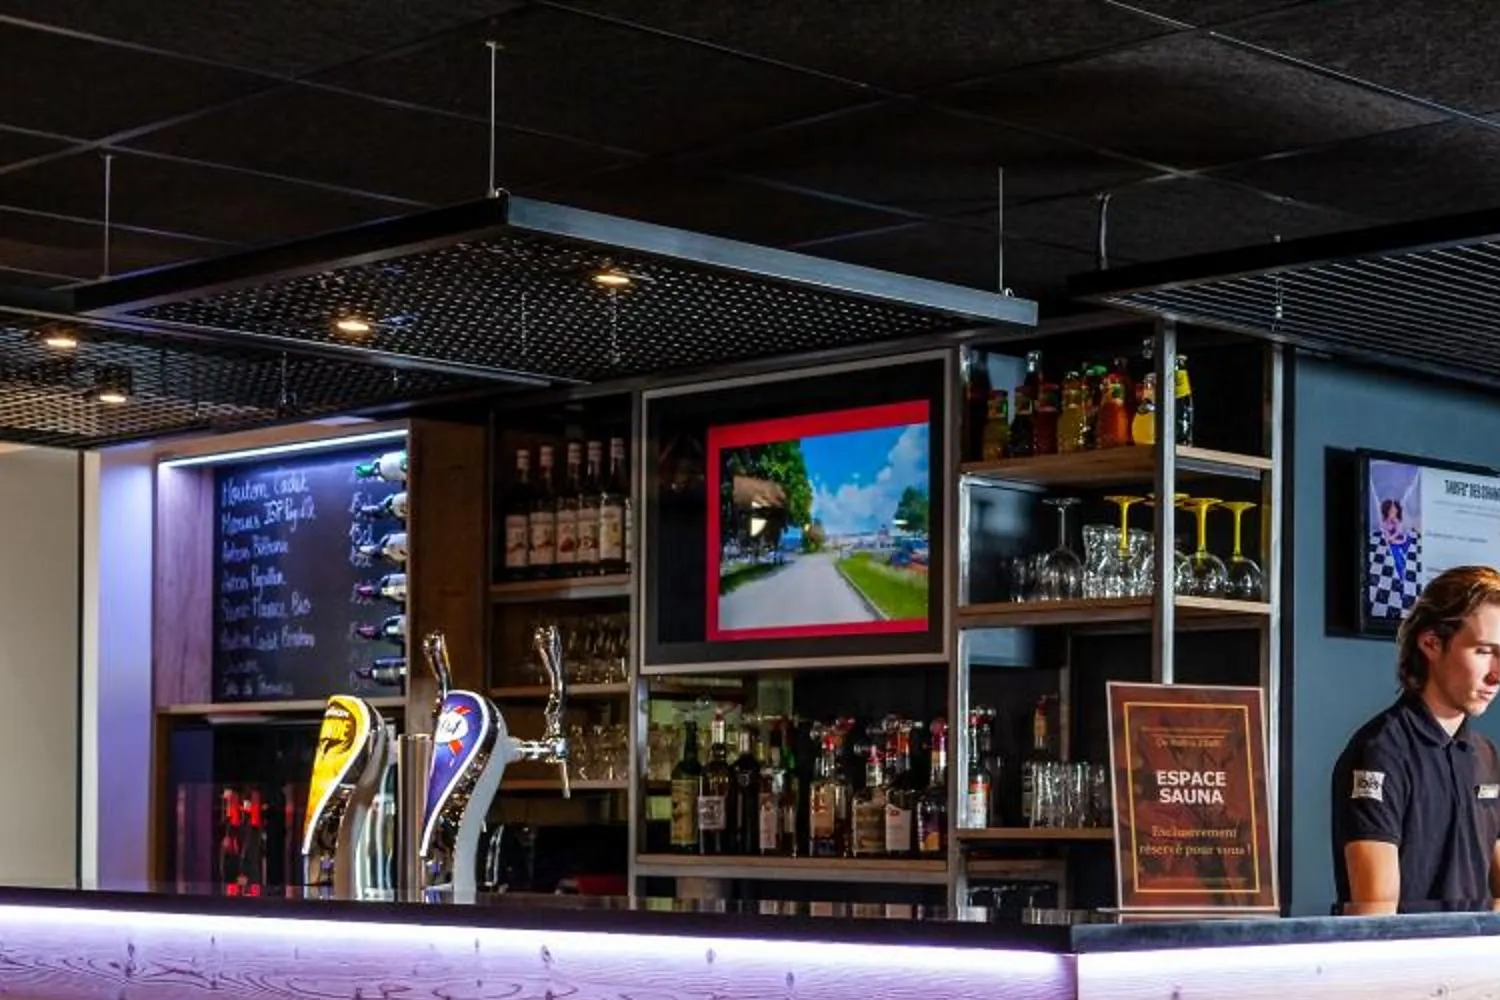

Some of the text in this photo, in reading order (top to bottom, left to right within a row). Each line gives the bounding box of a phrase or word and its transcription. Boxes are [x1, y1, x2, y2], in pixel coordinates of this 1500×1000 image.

[1156, 769, 1227, 787] ESPACE
[1159, 788, 1225, 805] SAUNA
[1151, 825, 1237, 838] Exclusivement
[1139, 843, 1183, 855] réservé
[1185, 846, 1213, 857] pour
[1216, 846, 1245, 855] vous
